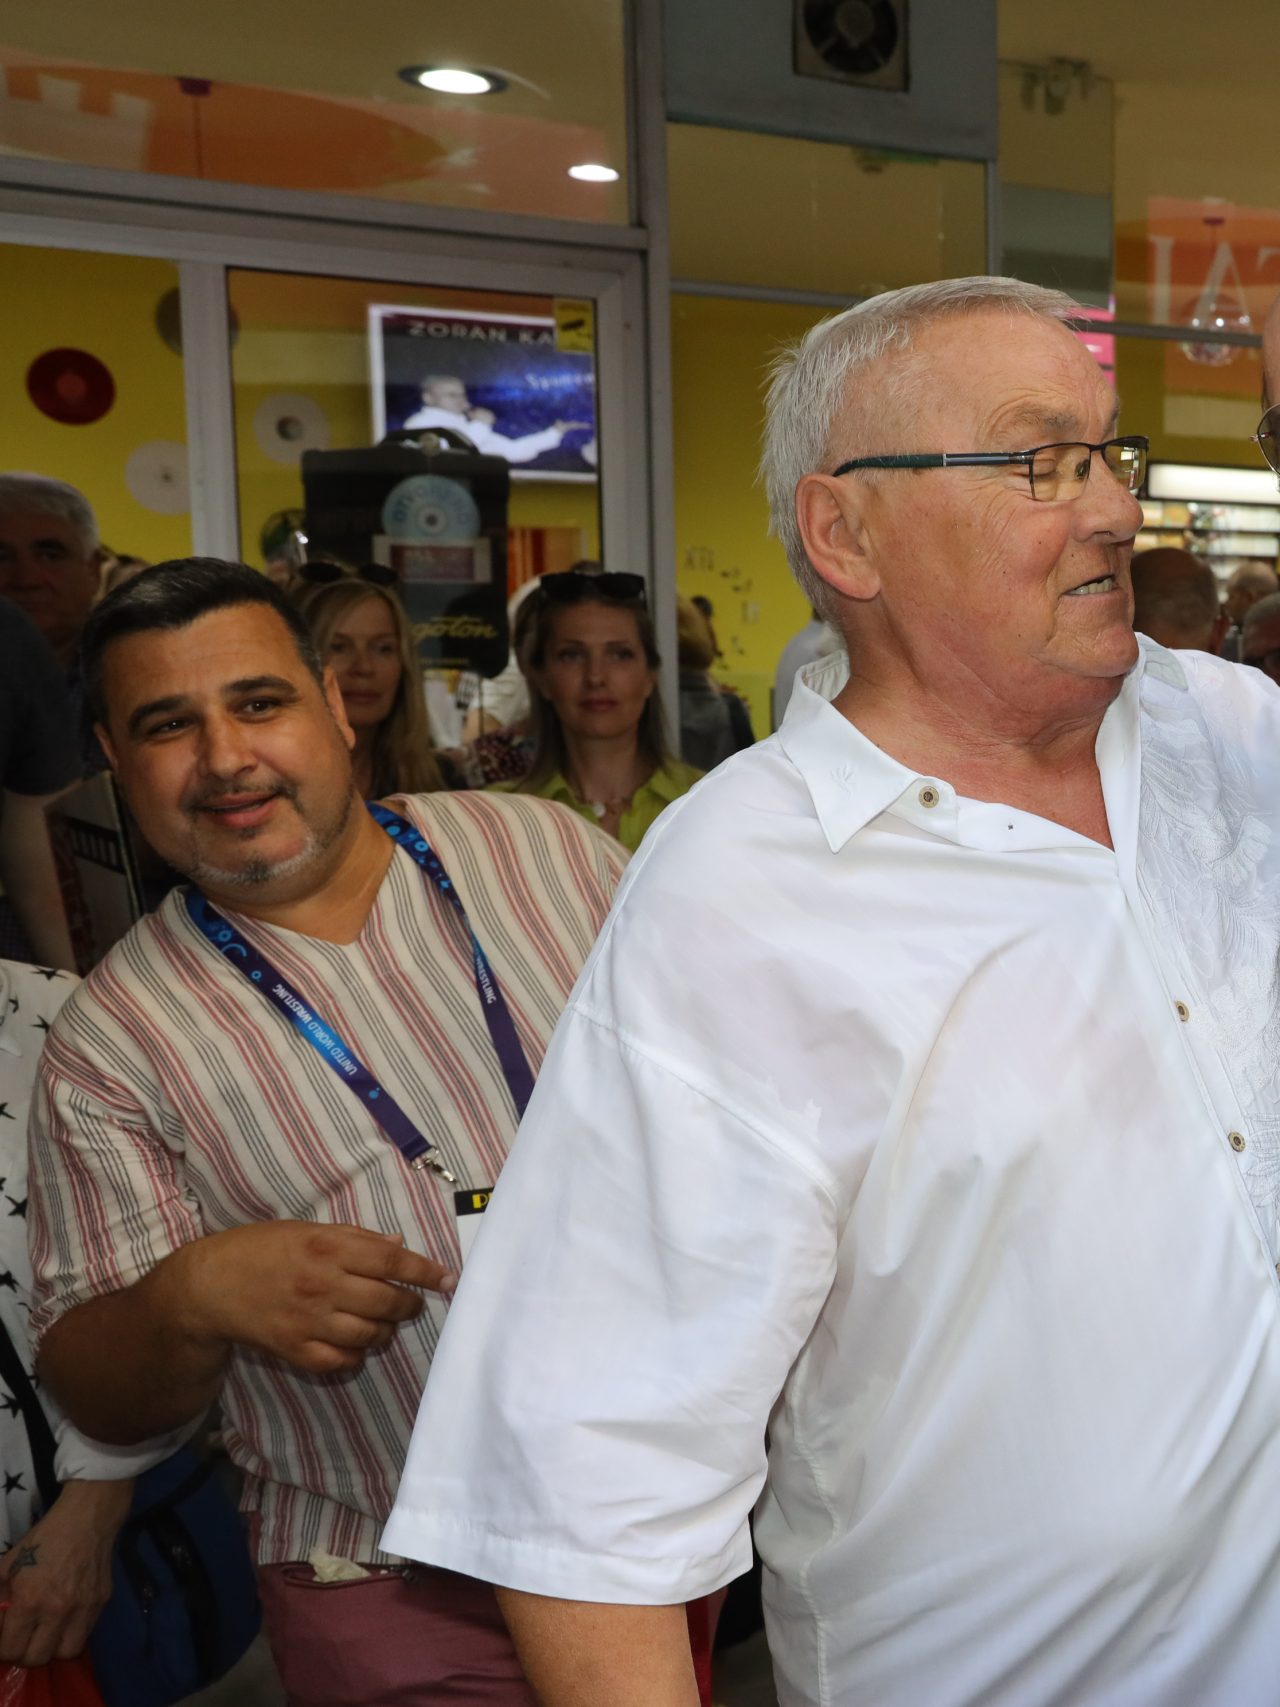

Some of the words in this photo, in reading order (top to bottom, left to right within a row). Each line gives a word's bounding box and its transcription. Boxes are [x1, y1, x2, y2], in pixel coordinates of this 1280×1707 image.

[408, 320, 507, 342] ZORAN
[271, 983, 313, 1024] WRESTLING
[308, 1022, 335, 1049] WORLD
[330, 1047, 358, 1076] UNITED
